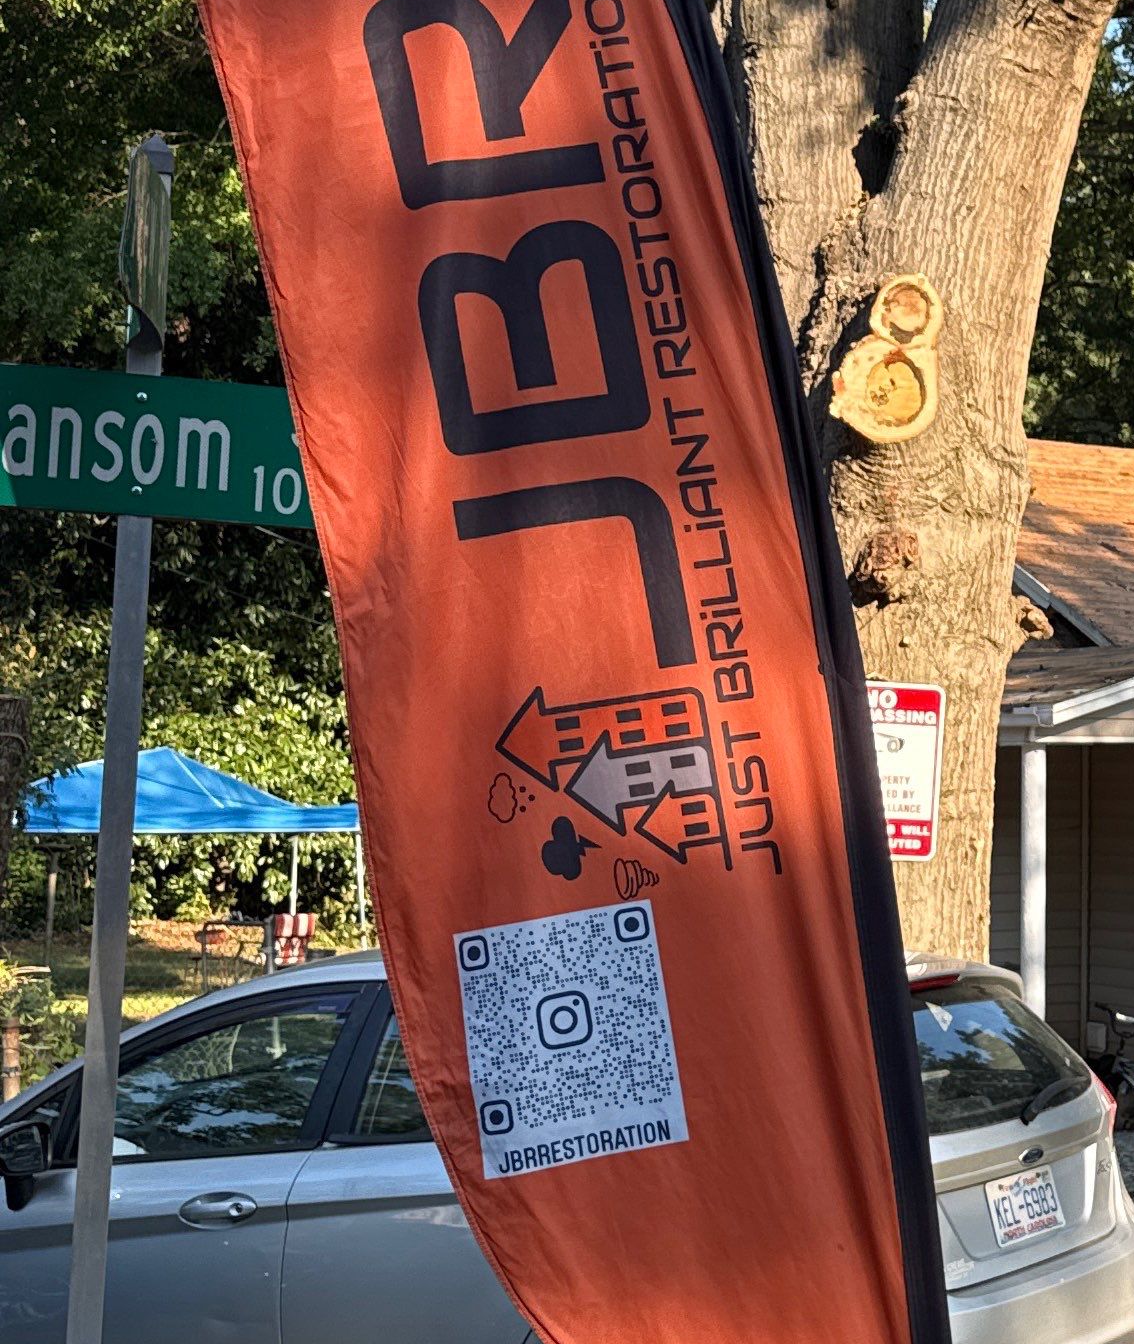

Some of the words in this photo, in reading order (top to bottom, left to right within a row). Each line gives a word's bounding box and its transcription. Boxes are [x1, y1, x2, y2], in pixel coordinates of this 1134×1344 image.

[2, 404, 230, 492] ansom
[870, 708, 937, 725] ASSING
[721, 722, 782, 875] JUST
[901, 824, 930, 836] WILL
[499, 1119, 671, 1173] JBRRESTORATION
